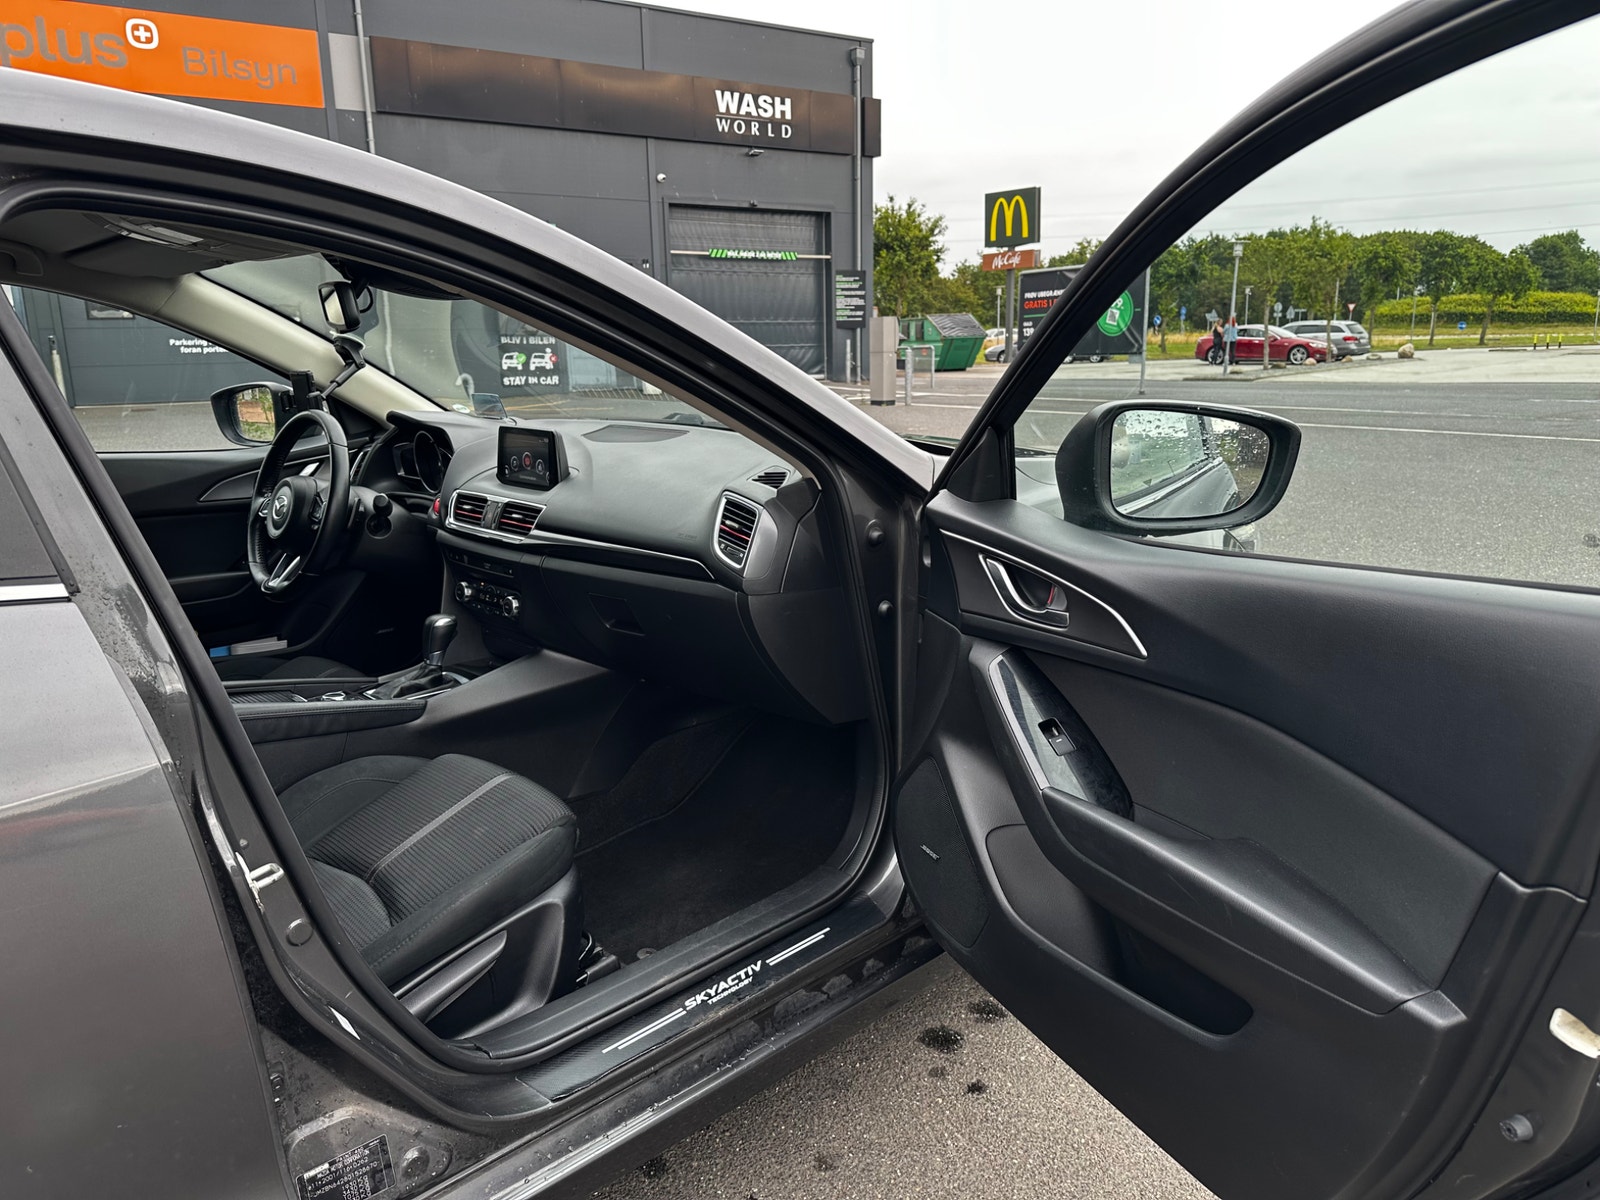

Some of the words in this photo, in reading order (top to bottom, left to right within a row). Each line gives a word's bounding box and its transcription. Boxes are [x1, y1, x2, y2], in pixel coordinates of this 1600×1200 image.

[182, 46, 297, 90] Bilsyn
[714, 89, 792, 120] WASH
[715, 117, 792, 139] WORLD
[992, 252, 1021, 270] McCafé
[1023, 300, 1048, 309] GRATIS
[169, 338, 208, 347] Parkering
[501, 336, 521, 344] BLIV
[529, 336, 556, 345] BILEN
[180, 346, 202, 354] foran
[503, 376, 527, 386] STAY
[528, 376, 539, 384] IN
[540, 375, 559, 385] CAR
[684, 960, 762, 1010] SKYACTIV
[707, 976, 753, 1005] TECHNOLOGY
